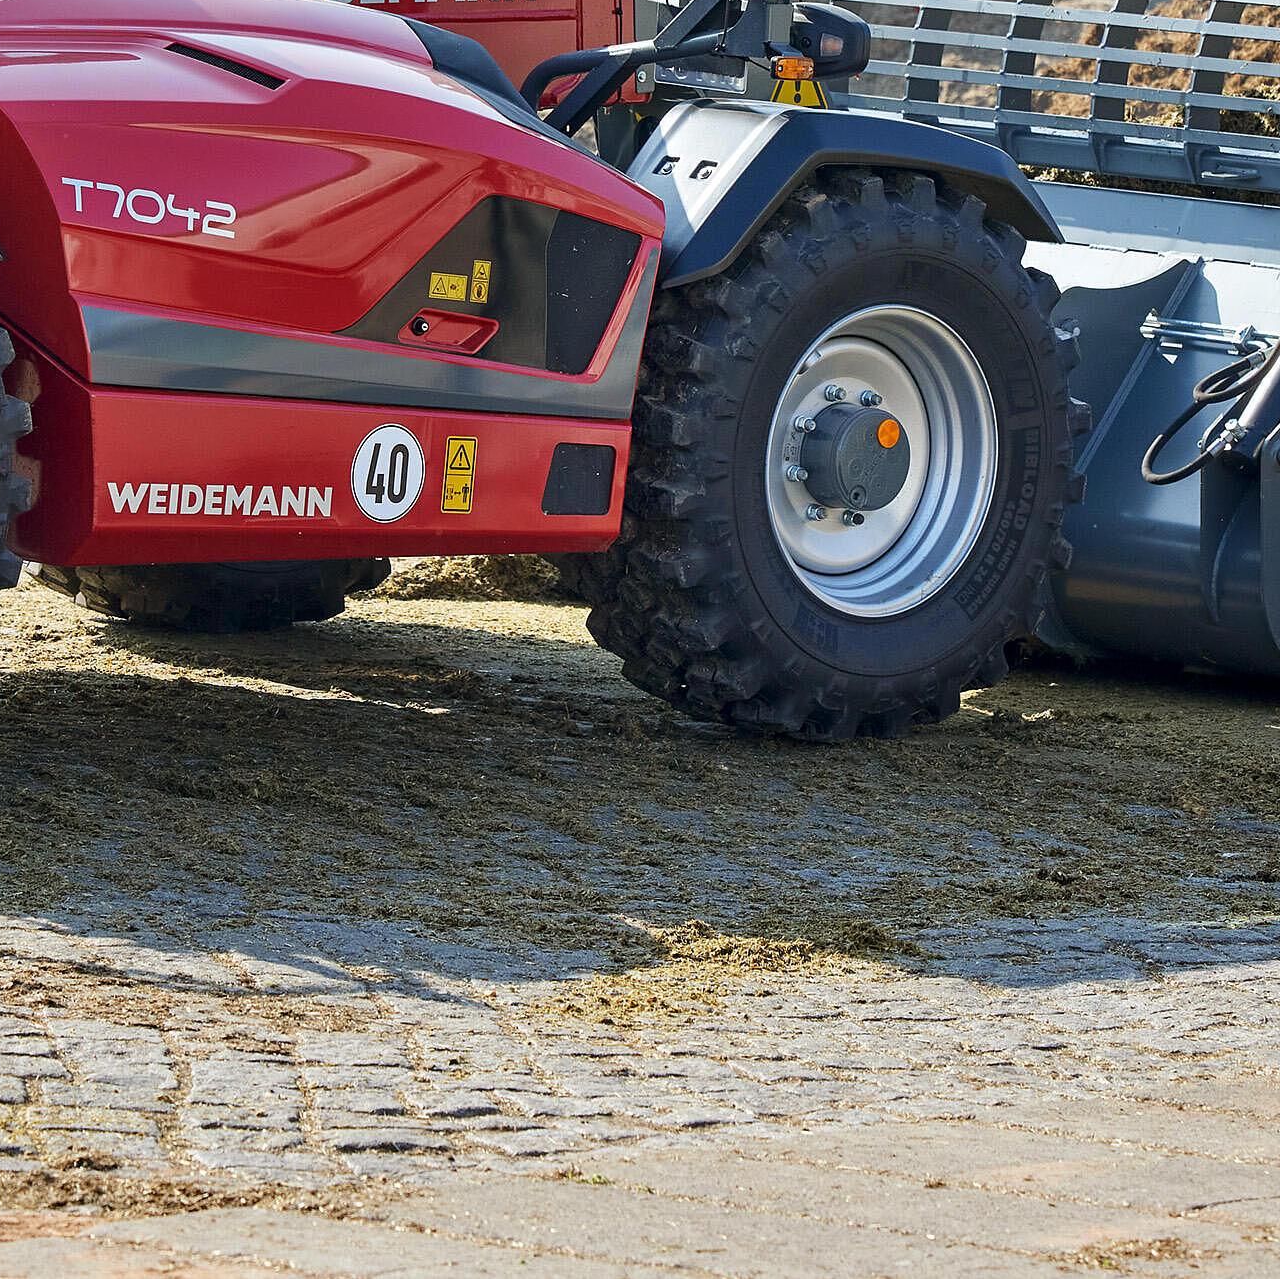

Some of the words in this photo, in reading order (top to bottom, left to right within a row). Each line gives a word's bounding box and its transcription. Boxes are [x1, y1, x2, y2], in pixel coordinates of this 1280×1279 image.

[61, 176, 237, 239] T7042
[107, 481, 333, 517] WEIDEMANN
[365, 443, 410, 504] 40
[1013, 429, 1041, 531] BIBLOAD
